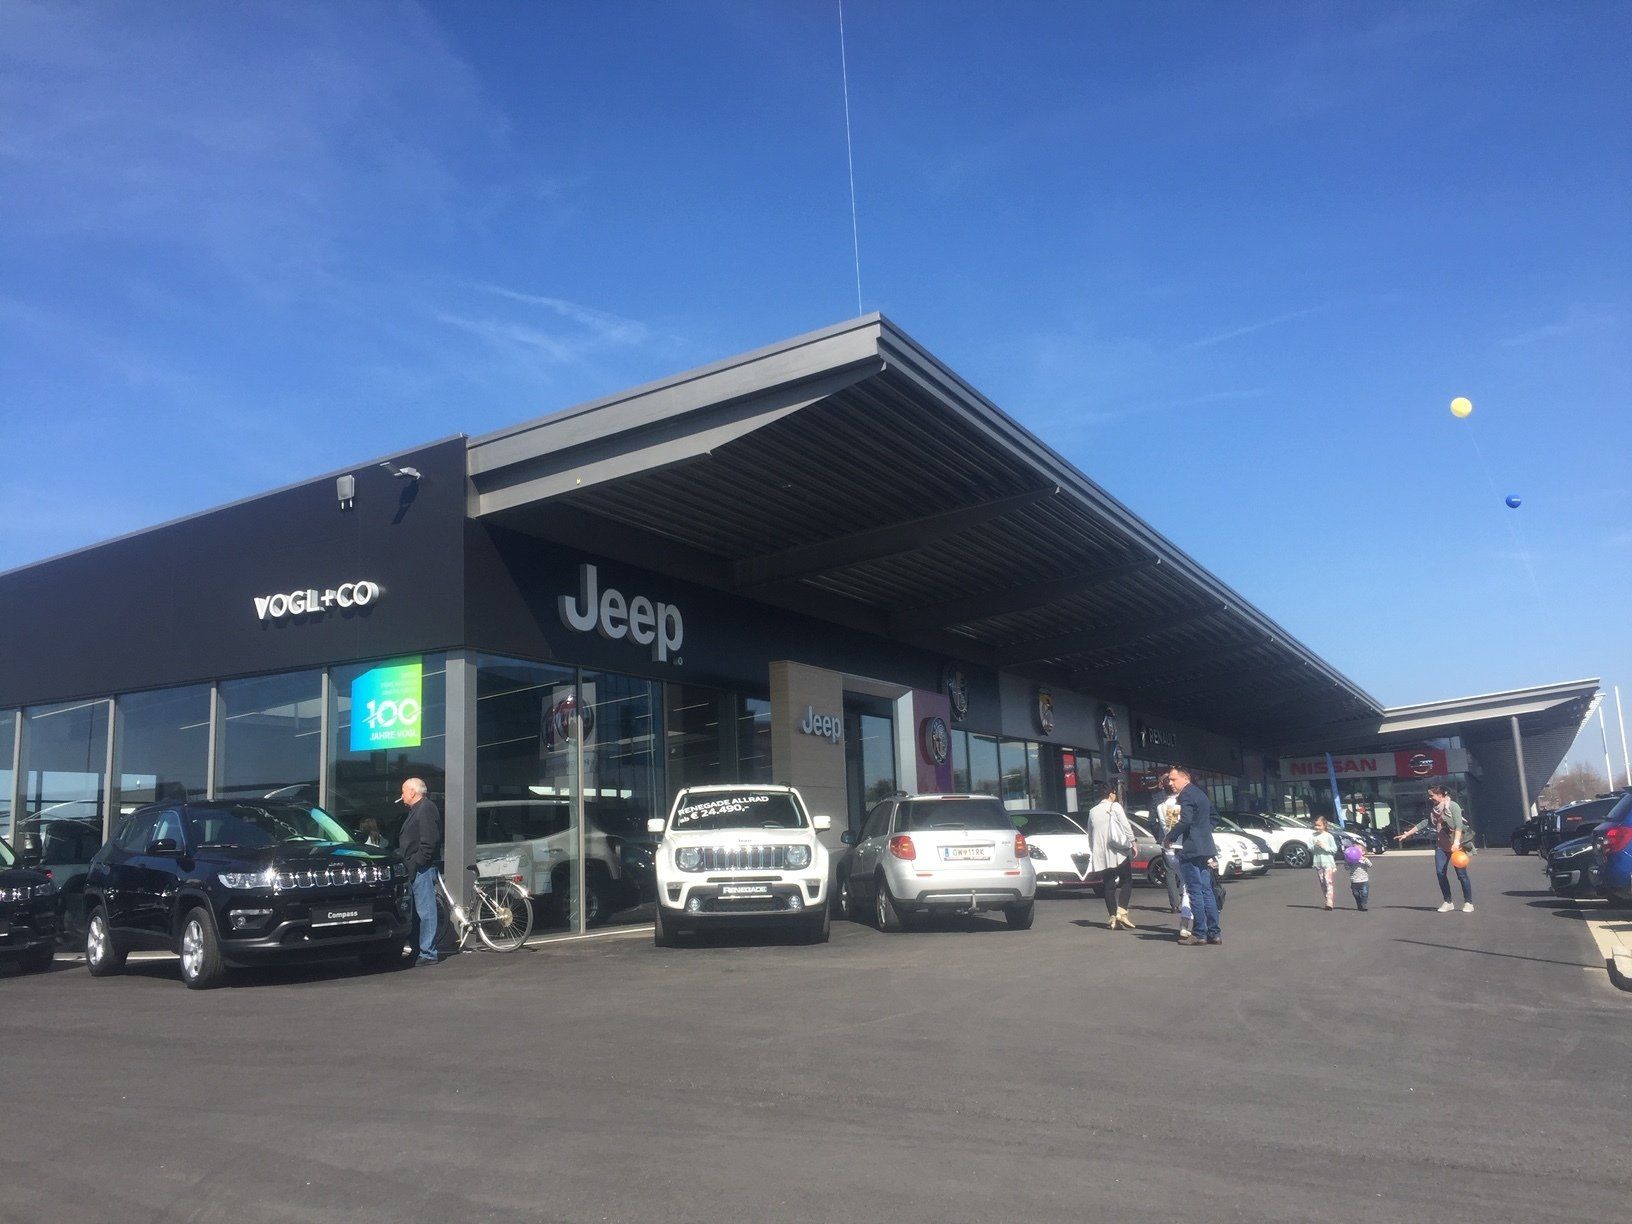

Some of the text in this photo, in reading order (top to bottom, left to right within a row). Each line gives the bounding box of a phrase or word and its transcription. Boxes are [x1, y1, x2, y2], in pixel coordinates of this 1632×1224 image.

[254, 580, 379, 620] VOGL+CO
[562, 563, 684, 662] Jeep
[366, 698, 421, 729] 100
[803, 704, 841, 743] Jeep
[1149, 728, 1176, 748] RENAULT
[1290, 758, 1377, 775] NISSAN
[678, 796, 769, 816] RENEGADE ALLRAD
[690, 811, 699, 821] €
[722, 886, 768, 895] RENEGADE
[327, 911, 359, 920] Compass
